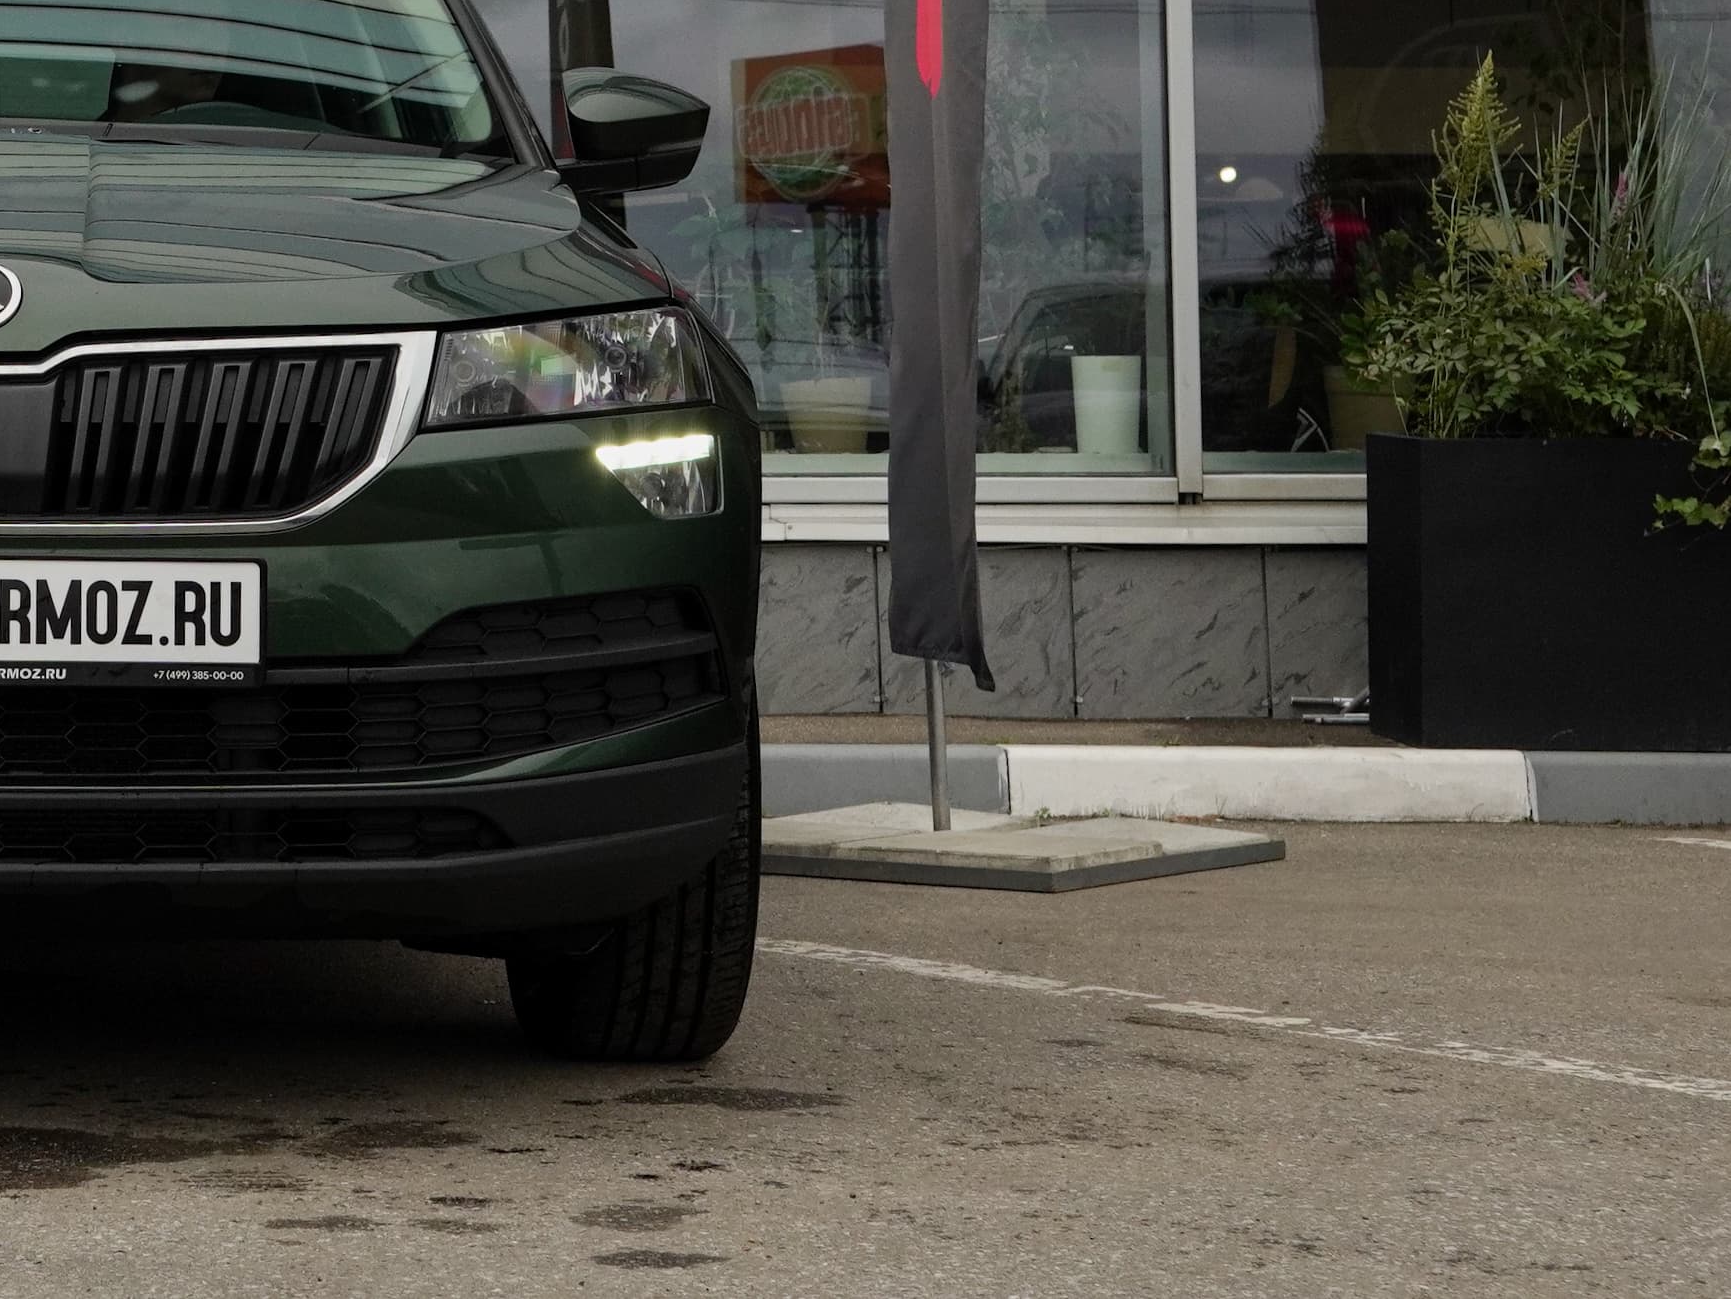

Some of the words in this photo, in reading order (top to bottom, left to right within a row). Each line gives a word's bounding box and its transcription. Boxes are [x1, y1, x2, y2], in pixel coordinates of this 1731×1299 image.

[153, 671, 165, 680] +7
[166, 670, 191, 681] (499)
[191, 670, 244, 681] 385-00-00
